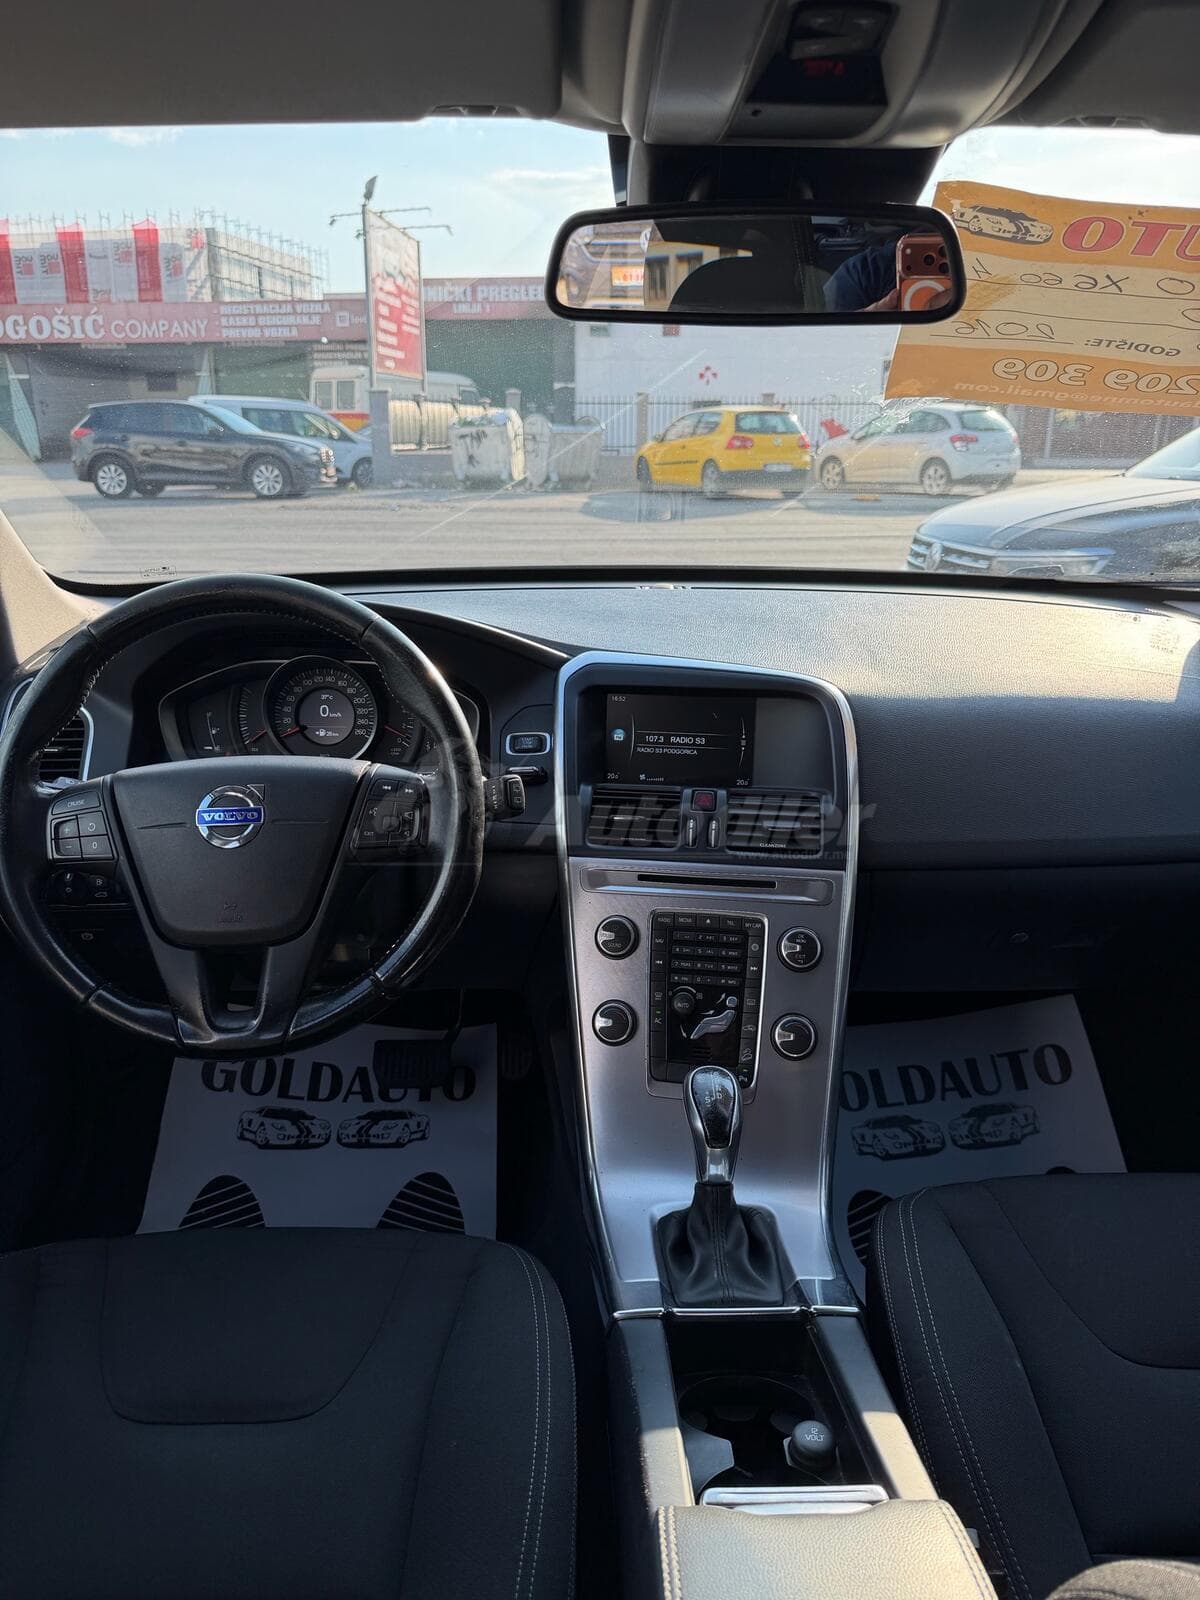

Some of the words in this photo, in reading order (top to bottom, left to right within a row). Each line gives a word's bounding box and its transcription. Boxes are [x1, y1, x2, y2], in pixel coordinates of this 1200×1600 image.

[0, 307, 106, 340] GOŠIĆ
[111, 319, 209, 339] COMPANY
[320, 705, 329, 717] 0
[671, 736, 694, 744] RADIO
[695, 737, 706, 745] S3
[201, 811, 259, 822] VOLVO
[201, 1057, 477, 1104] GOLDAO
[839, 1043, 1073, 1112] OLDAUTO
[805, 1434, 825, 1442] VOLT
